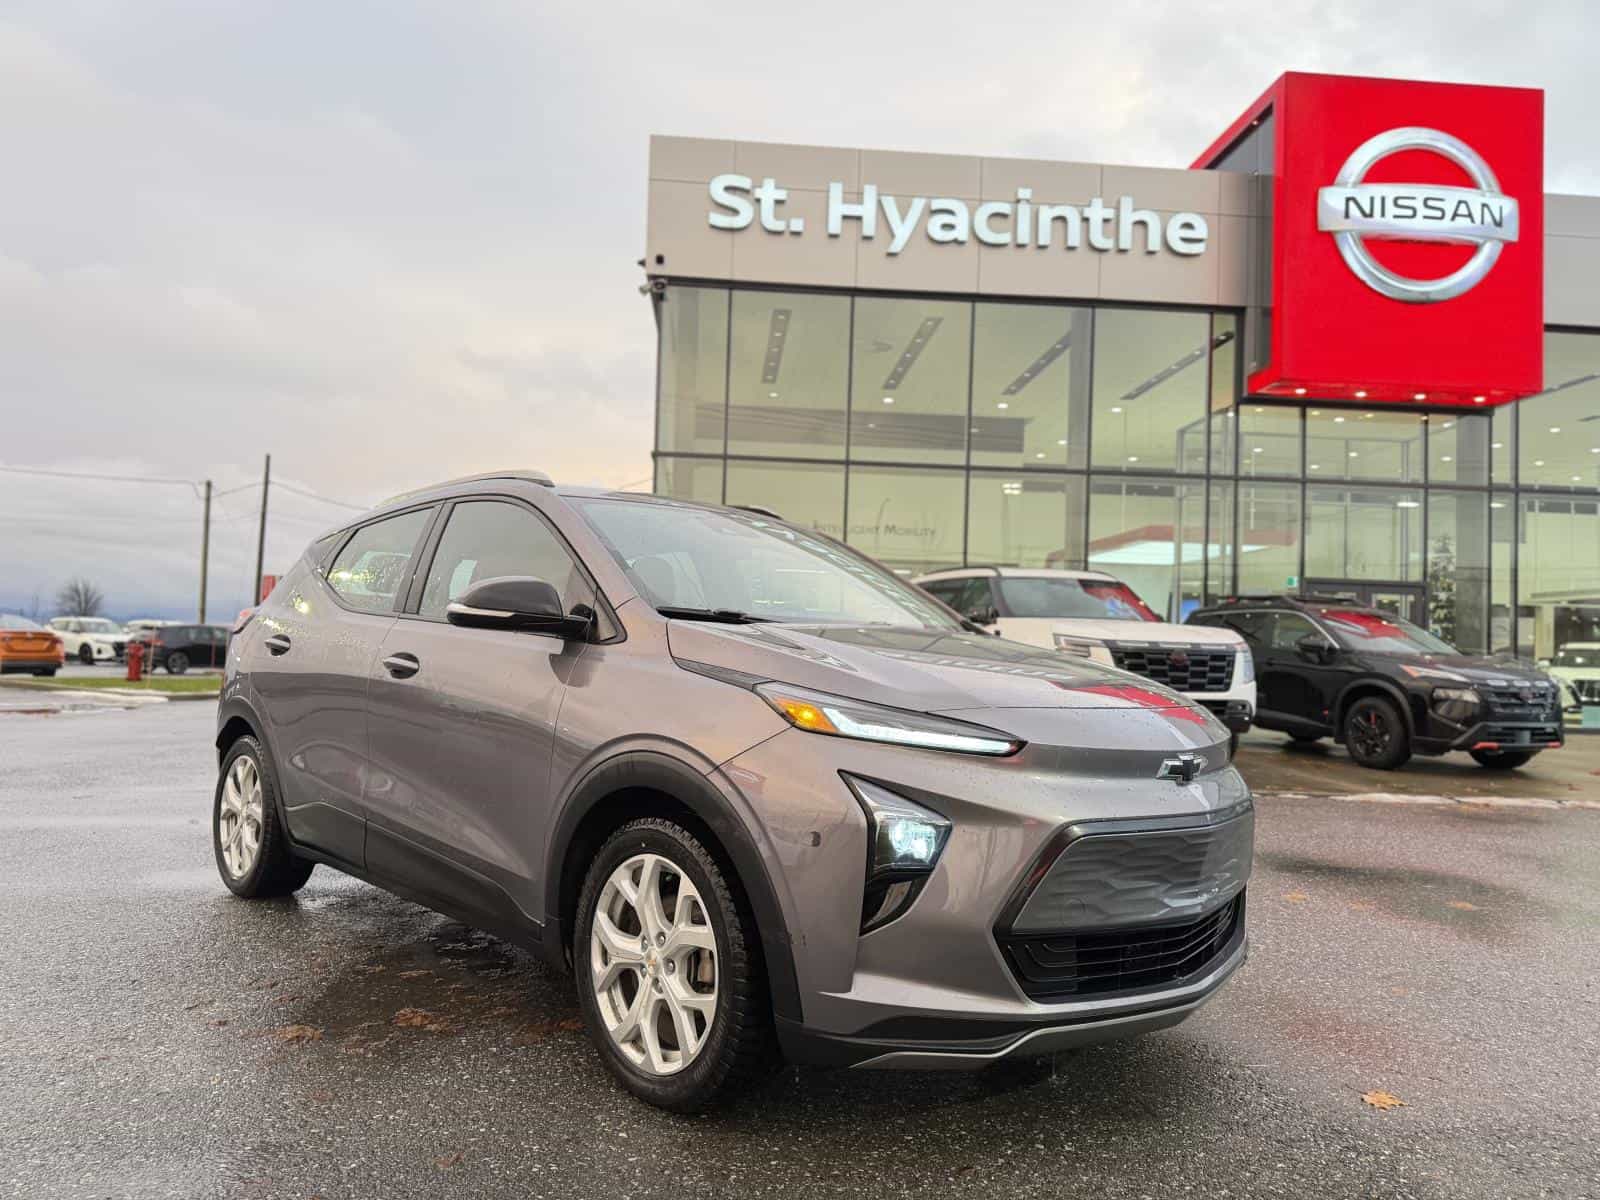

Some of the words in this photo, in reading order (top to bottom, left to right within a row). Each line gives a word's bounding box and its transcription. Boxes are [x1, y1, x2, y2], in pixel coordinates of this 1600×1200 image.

[708, 173, 805, 234] St.
[827, 181, 1209, 256] Hyacinthe
[1343, 195, 1504, 228] NISSAN
